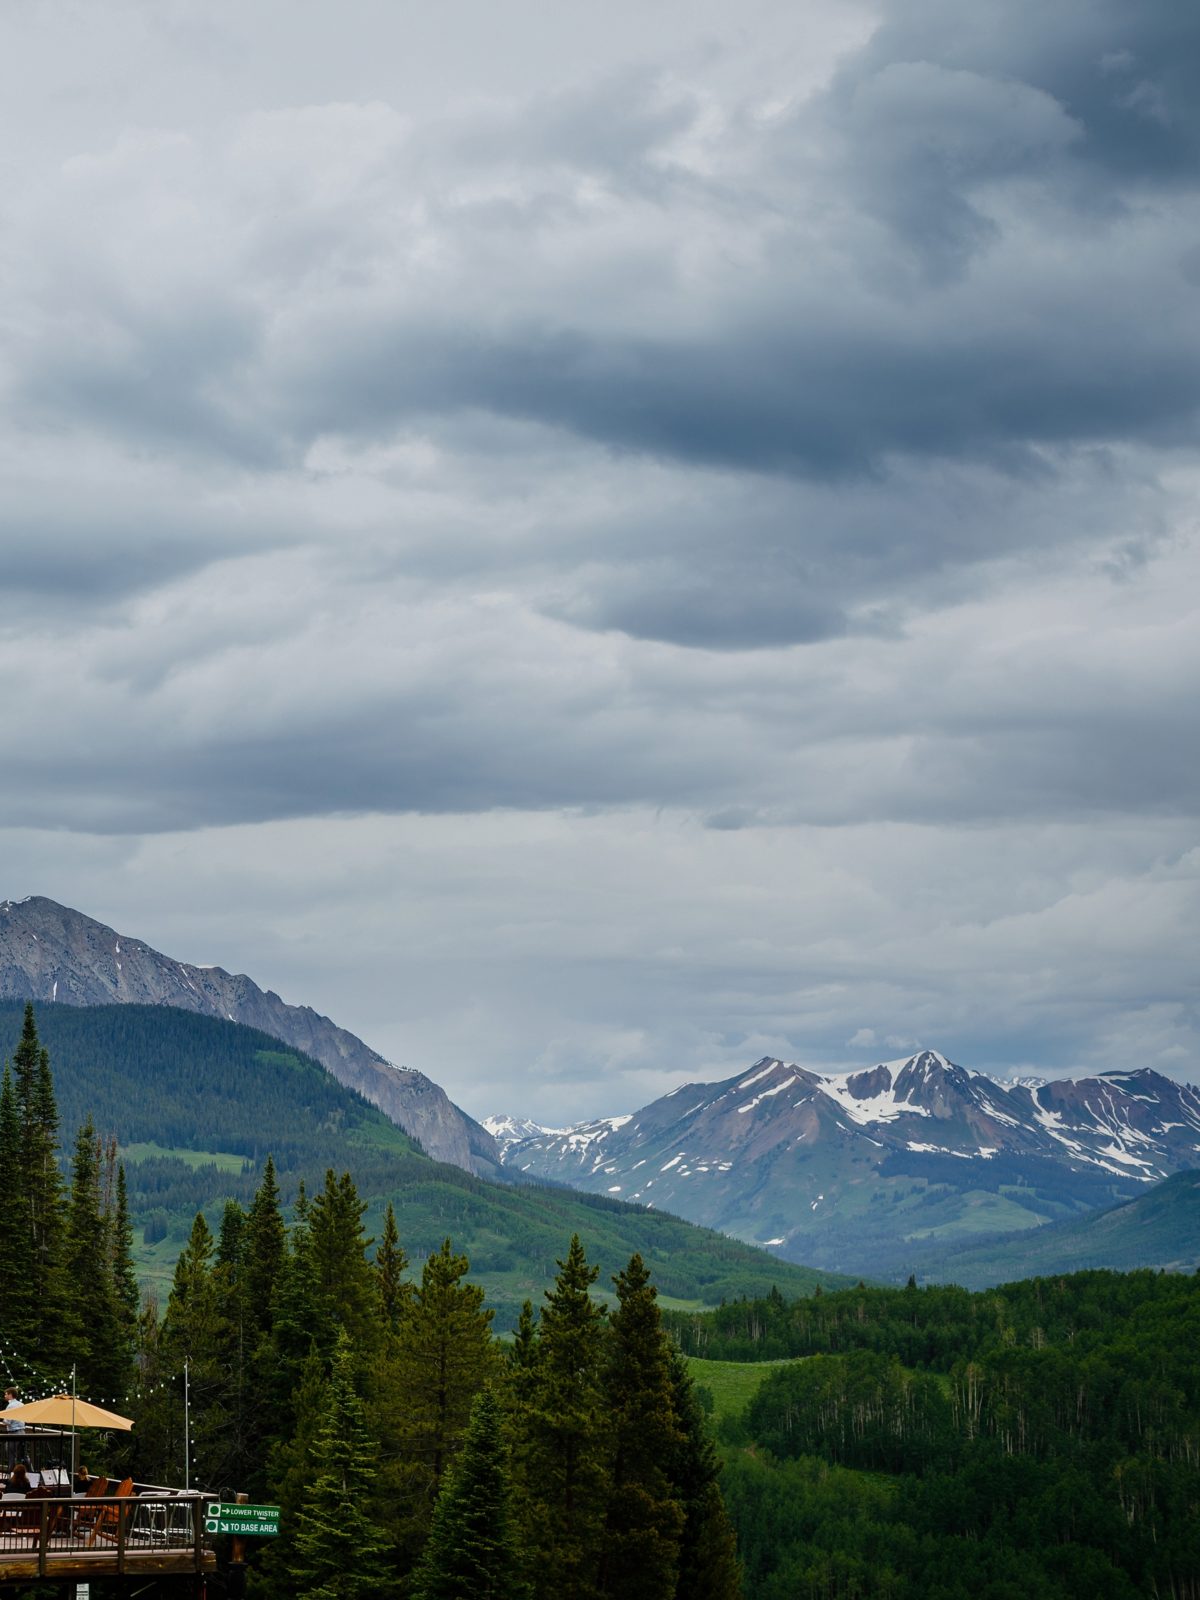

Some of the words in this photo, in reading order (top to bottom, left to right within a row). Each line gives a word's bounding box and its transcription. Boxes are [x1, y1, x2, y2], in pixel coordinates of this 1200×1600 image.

[230, 1508, 252, 1516] LOWER
[253, 1509, 279, 1517] TWISTER
[230, 1523, 240, 1531] TO
[240, 1523, 259, 1532] BASE
[260, 1524, 278, 1533] AREA
